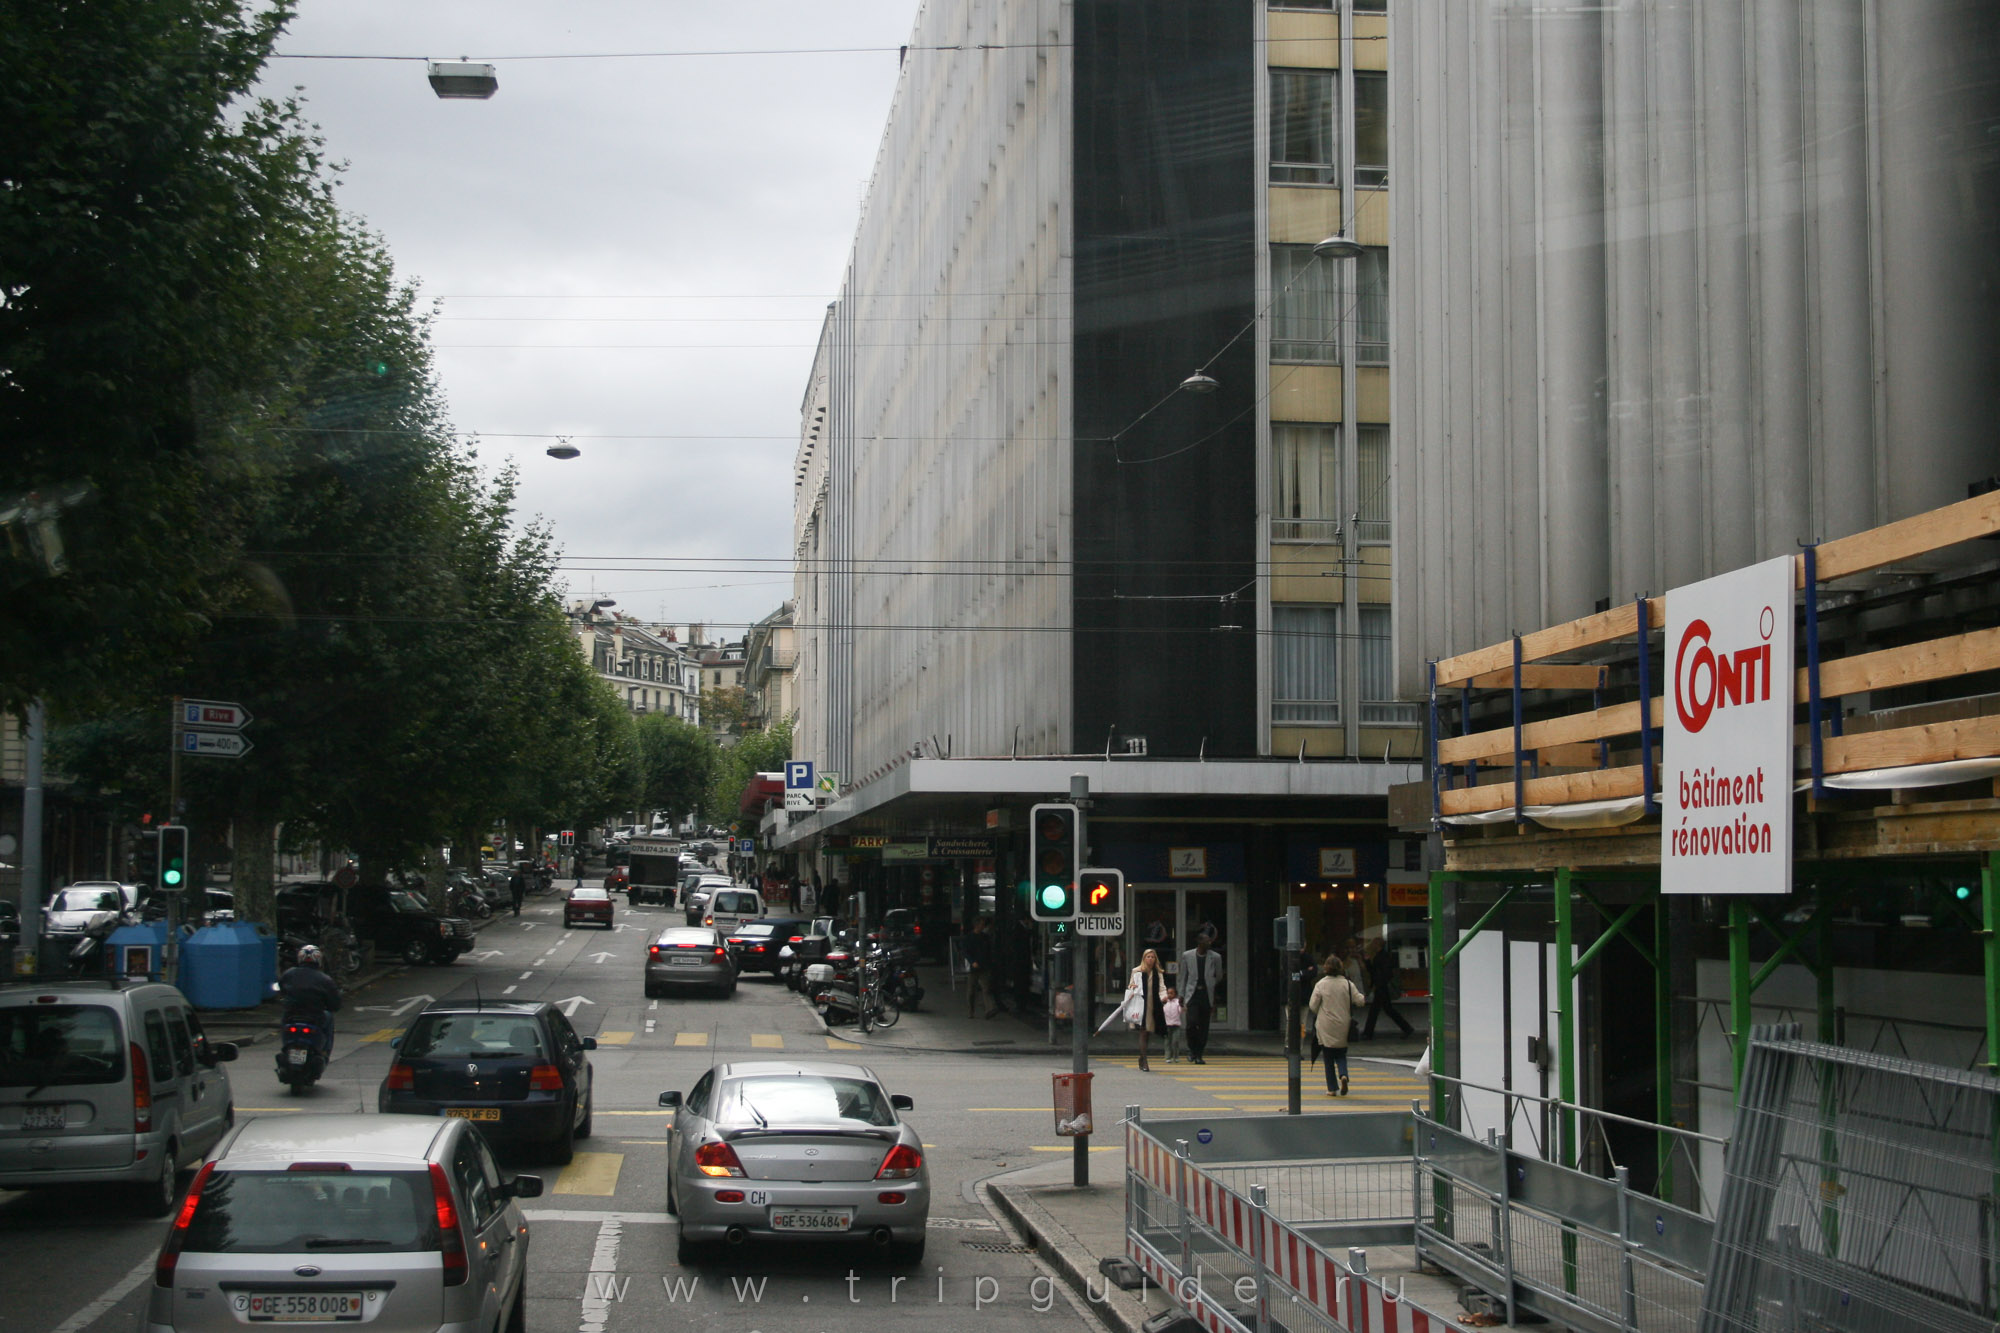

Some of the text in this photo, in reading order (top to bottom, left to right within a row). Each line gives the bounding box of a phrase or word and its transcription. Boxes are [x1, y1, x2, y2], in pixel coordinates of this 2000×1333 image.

[208, 709, 230, 720] Rive
[188, 736, 195, 750] P
[792, 764, 808, 786] P
[1679, 766, 1764, 810] bâtiment
[1672, 812, 1771, 856] rénovation
[744, 841, 751, 850] P
[936, 839, 989, 848] Sandwicherie
[941, 847, 993, 856] Croissanterie
[1077, 914, 1122, 930] PIÉTONS
[486, 1109, 498, 1120] 69
[751, 1191, 766, 1204] CH
[238, 1299, 245, 1308] 7
